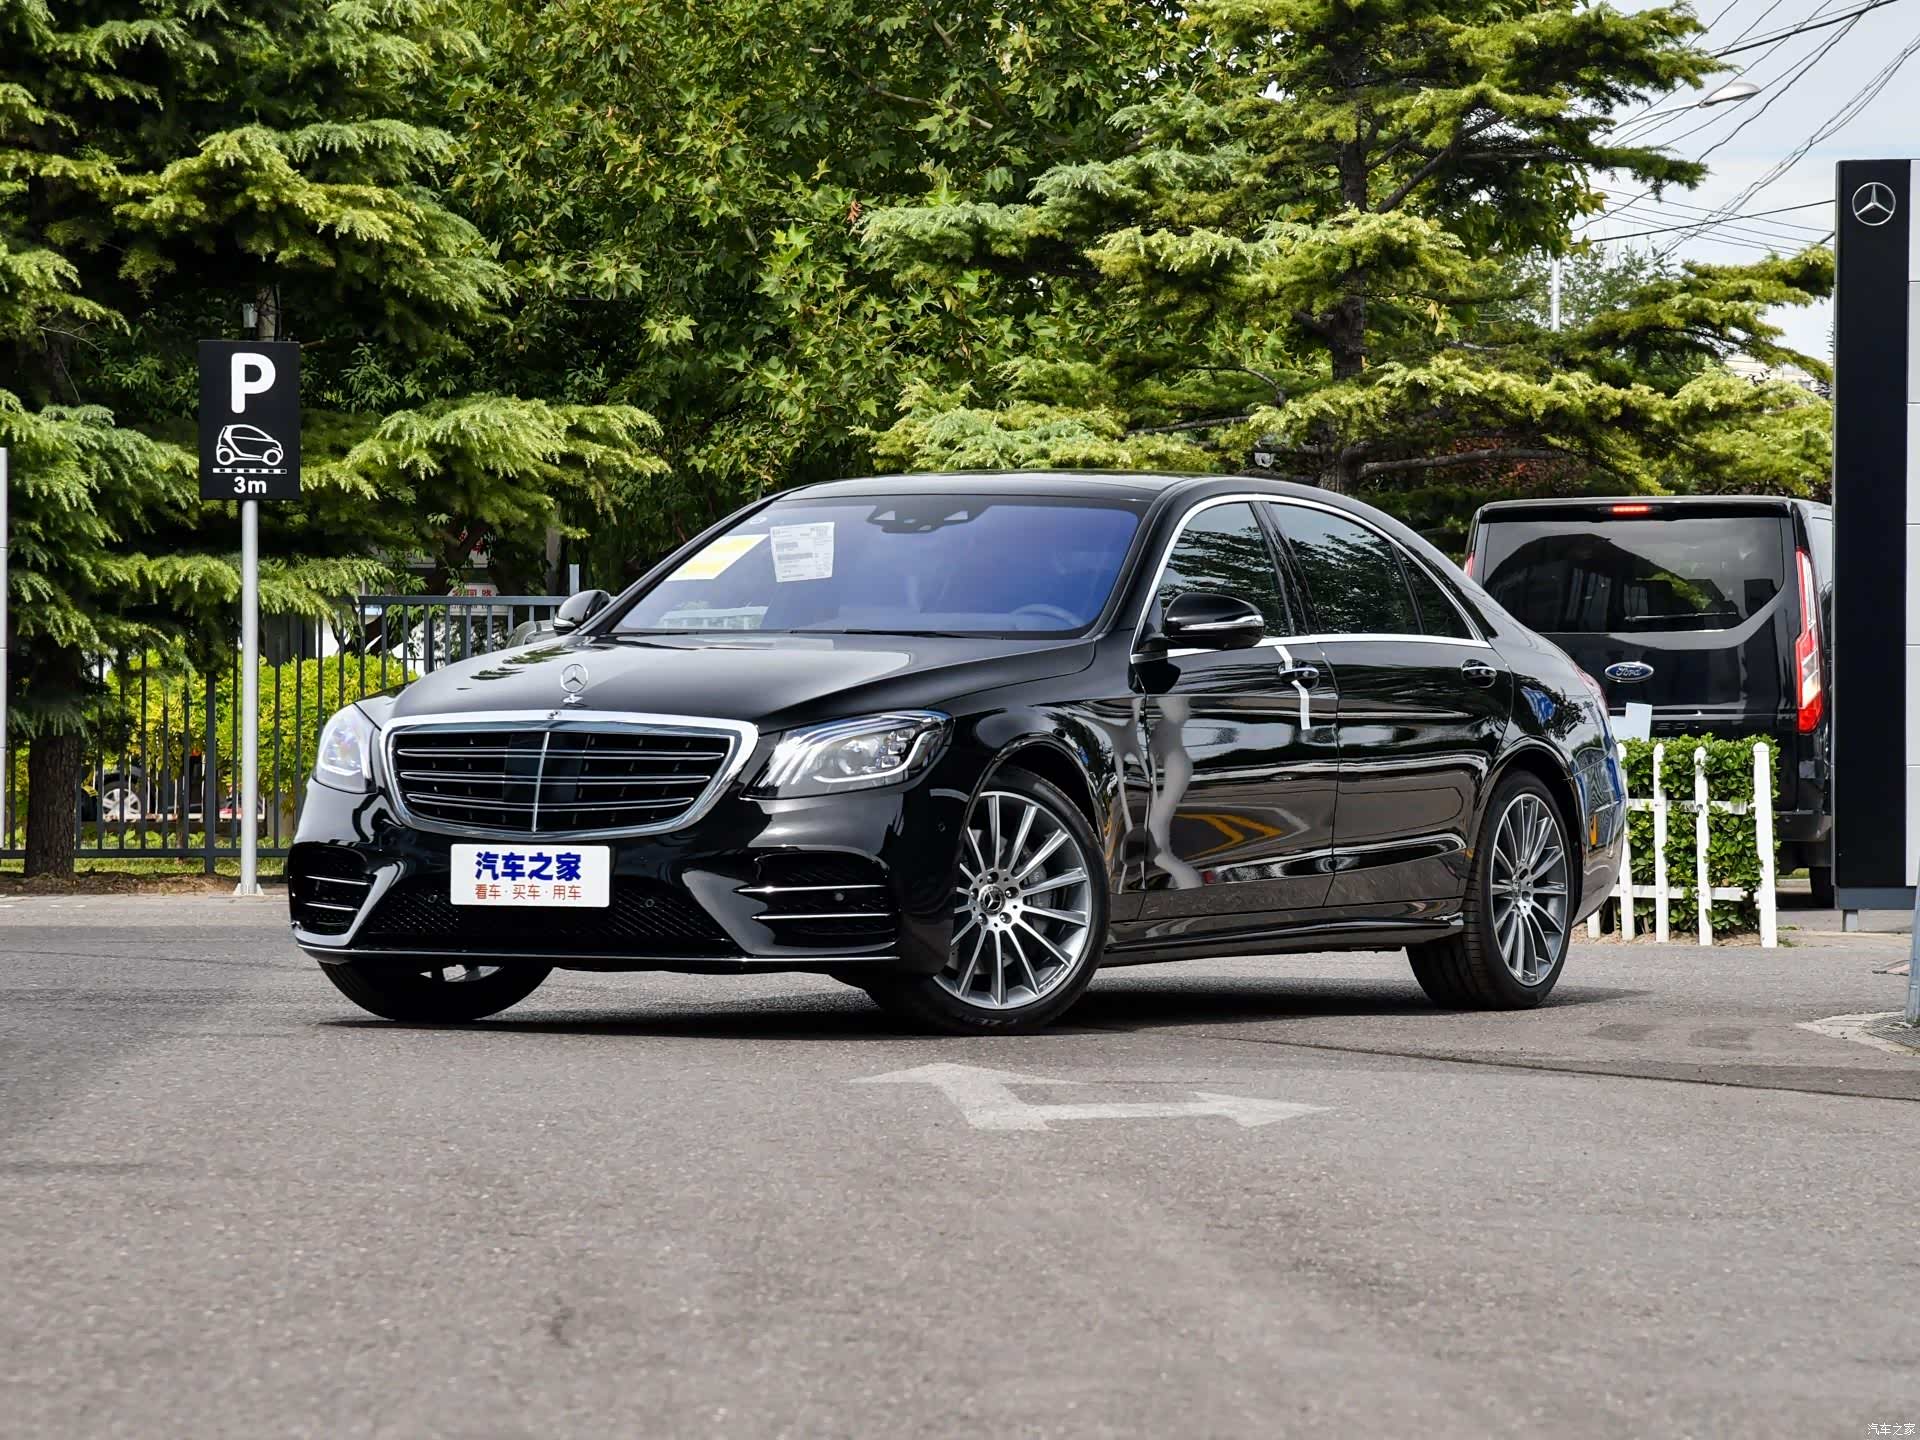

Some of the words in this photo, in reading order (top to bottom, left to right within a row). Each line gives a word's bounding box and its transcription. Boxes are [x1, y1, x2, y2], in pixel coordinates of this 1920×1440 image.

[231, 352, 276, 414] P
[233, 476, 267, 494] 3m
[1615, 666, 1643, 677] Ford
[475, 851, 582, 882] 汽车之家
